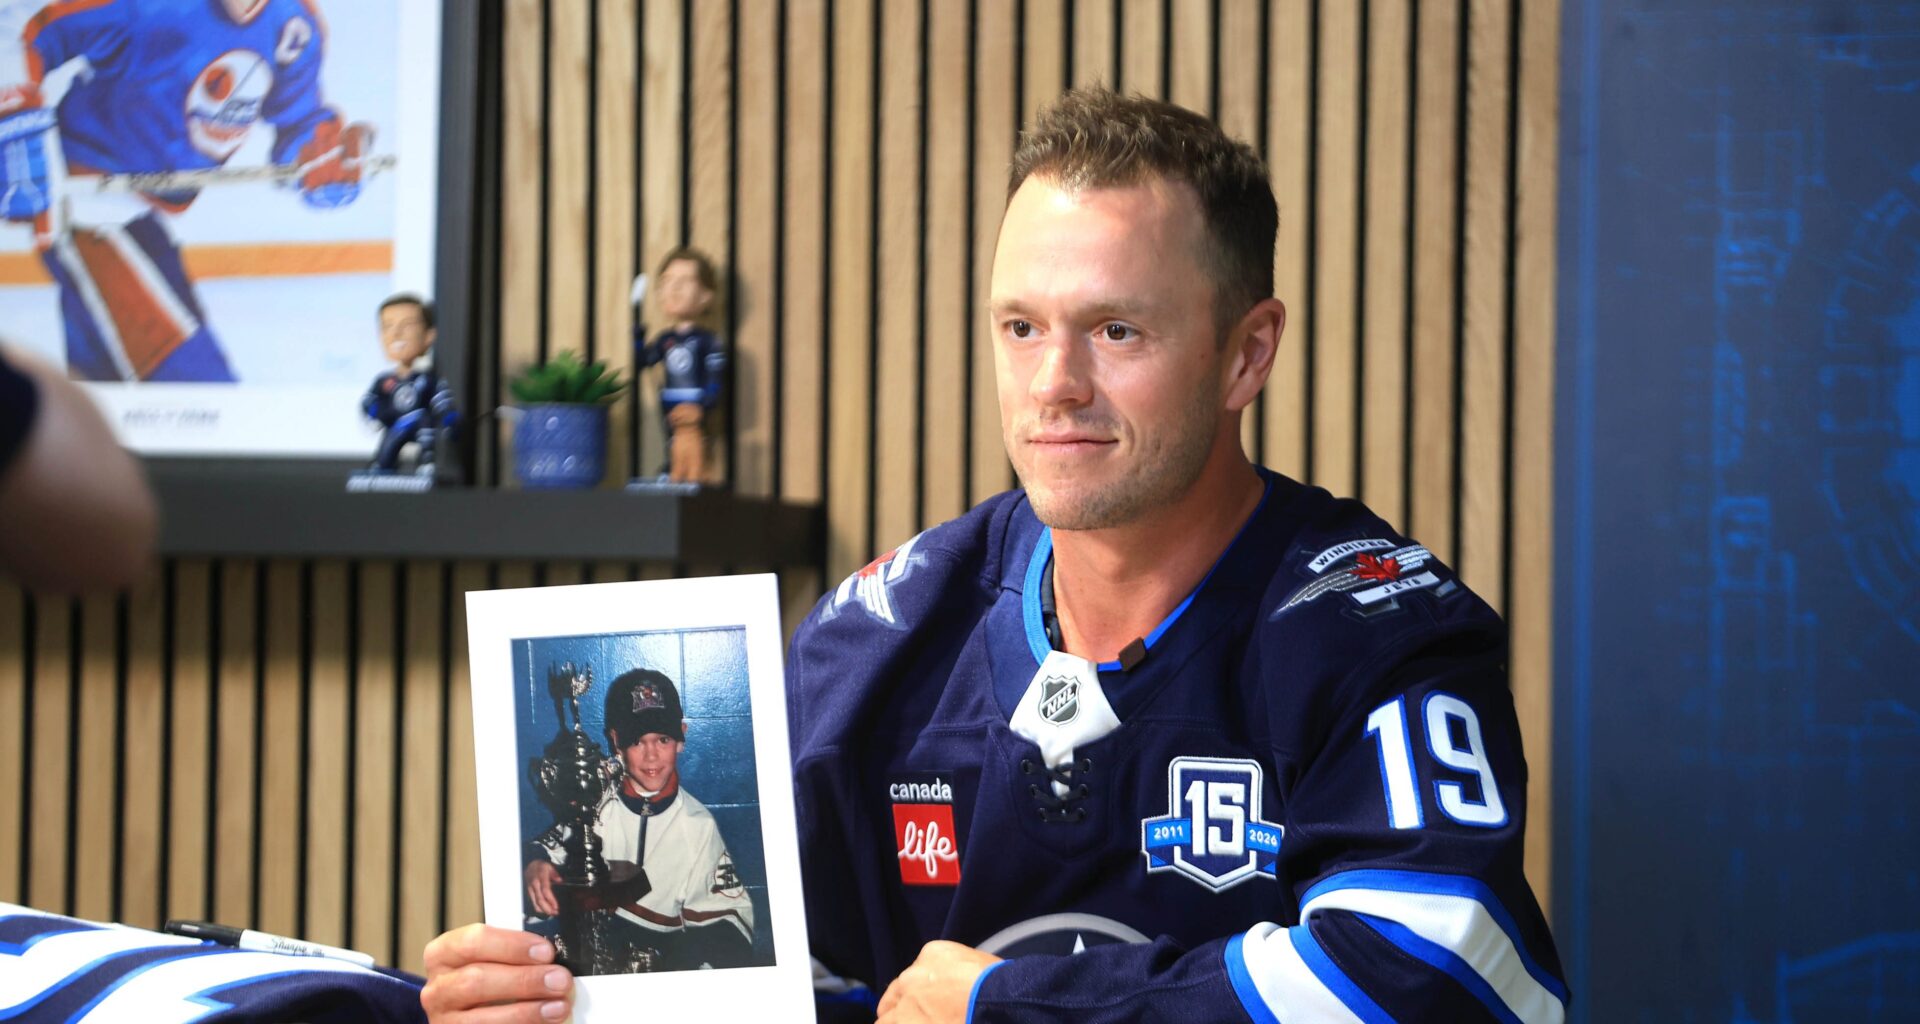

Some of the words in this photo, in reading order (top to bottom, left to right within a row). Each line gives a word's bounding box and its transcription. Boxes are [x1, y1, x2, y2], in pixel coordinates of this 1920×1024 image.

[1315, 539, 1390, 566] WINNIPEG
[1383, 578, 1422, 594] JETS
[1046, 687, 1076, 718] NHL
[1363, 689, 1511, 830] 19
[890, 777, 953, 800] canada
[1184, 780, 1245, 856] 15
[1153, 825, 1185, 840] 2011
[1249, 829, 1279, 846] 2026
[897, 821, 959, 879] life
